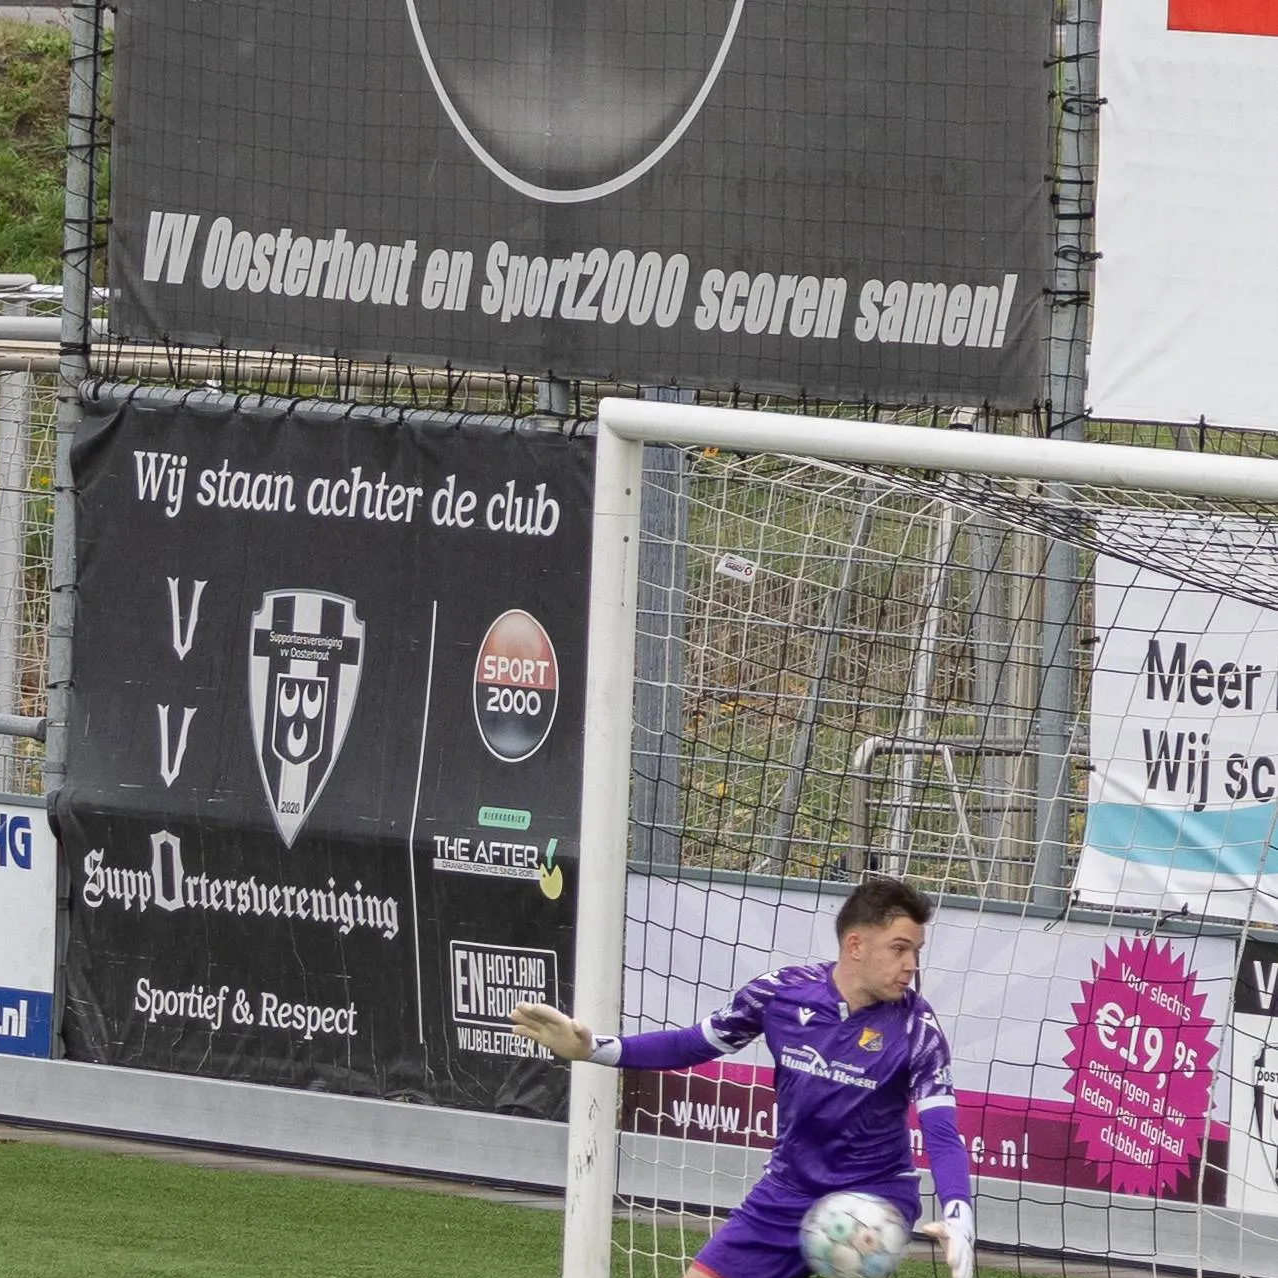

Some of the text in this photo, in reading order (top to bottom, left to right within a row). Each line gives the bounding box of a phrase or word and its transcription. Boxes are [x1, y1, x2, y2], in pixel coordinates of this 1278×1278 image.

[143, 211, 1018, 348] VV Oosterhout en Sport2000 scoren samen!
[133, 451, 561, 537] Wij staan achter de club
[167, 577, 208, 661] V
[269, 631, 343, 650] Supportersvereniging
[291, 647, 329, 660] Oosterhout
[483, 655, 550, 686] SPORT
[1147, 639, 1261, 710] Meer
[486, 686, 541, 716] 2000
[157, 704, 197, 788] V
[1143, 728, 1210, 812] Wij
[83, 830, 398, 940] SuppOrtersvereniging
[433, 835, 539, 868] THE AFTER
[135, 977, 357, 1040] Sportief & Respect
[455, 950, 546, 1015] EN HOFLAND
[1121, 963, 1191, 1021] Voor slechts
[1081, 1080, 1184, 1157] leden een digitaal
[1089, 1060, 1187, 1129] ontvangen al uw
[1101, 1125, 1154, 1169] clubblad!
